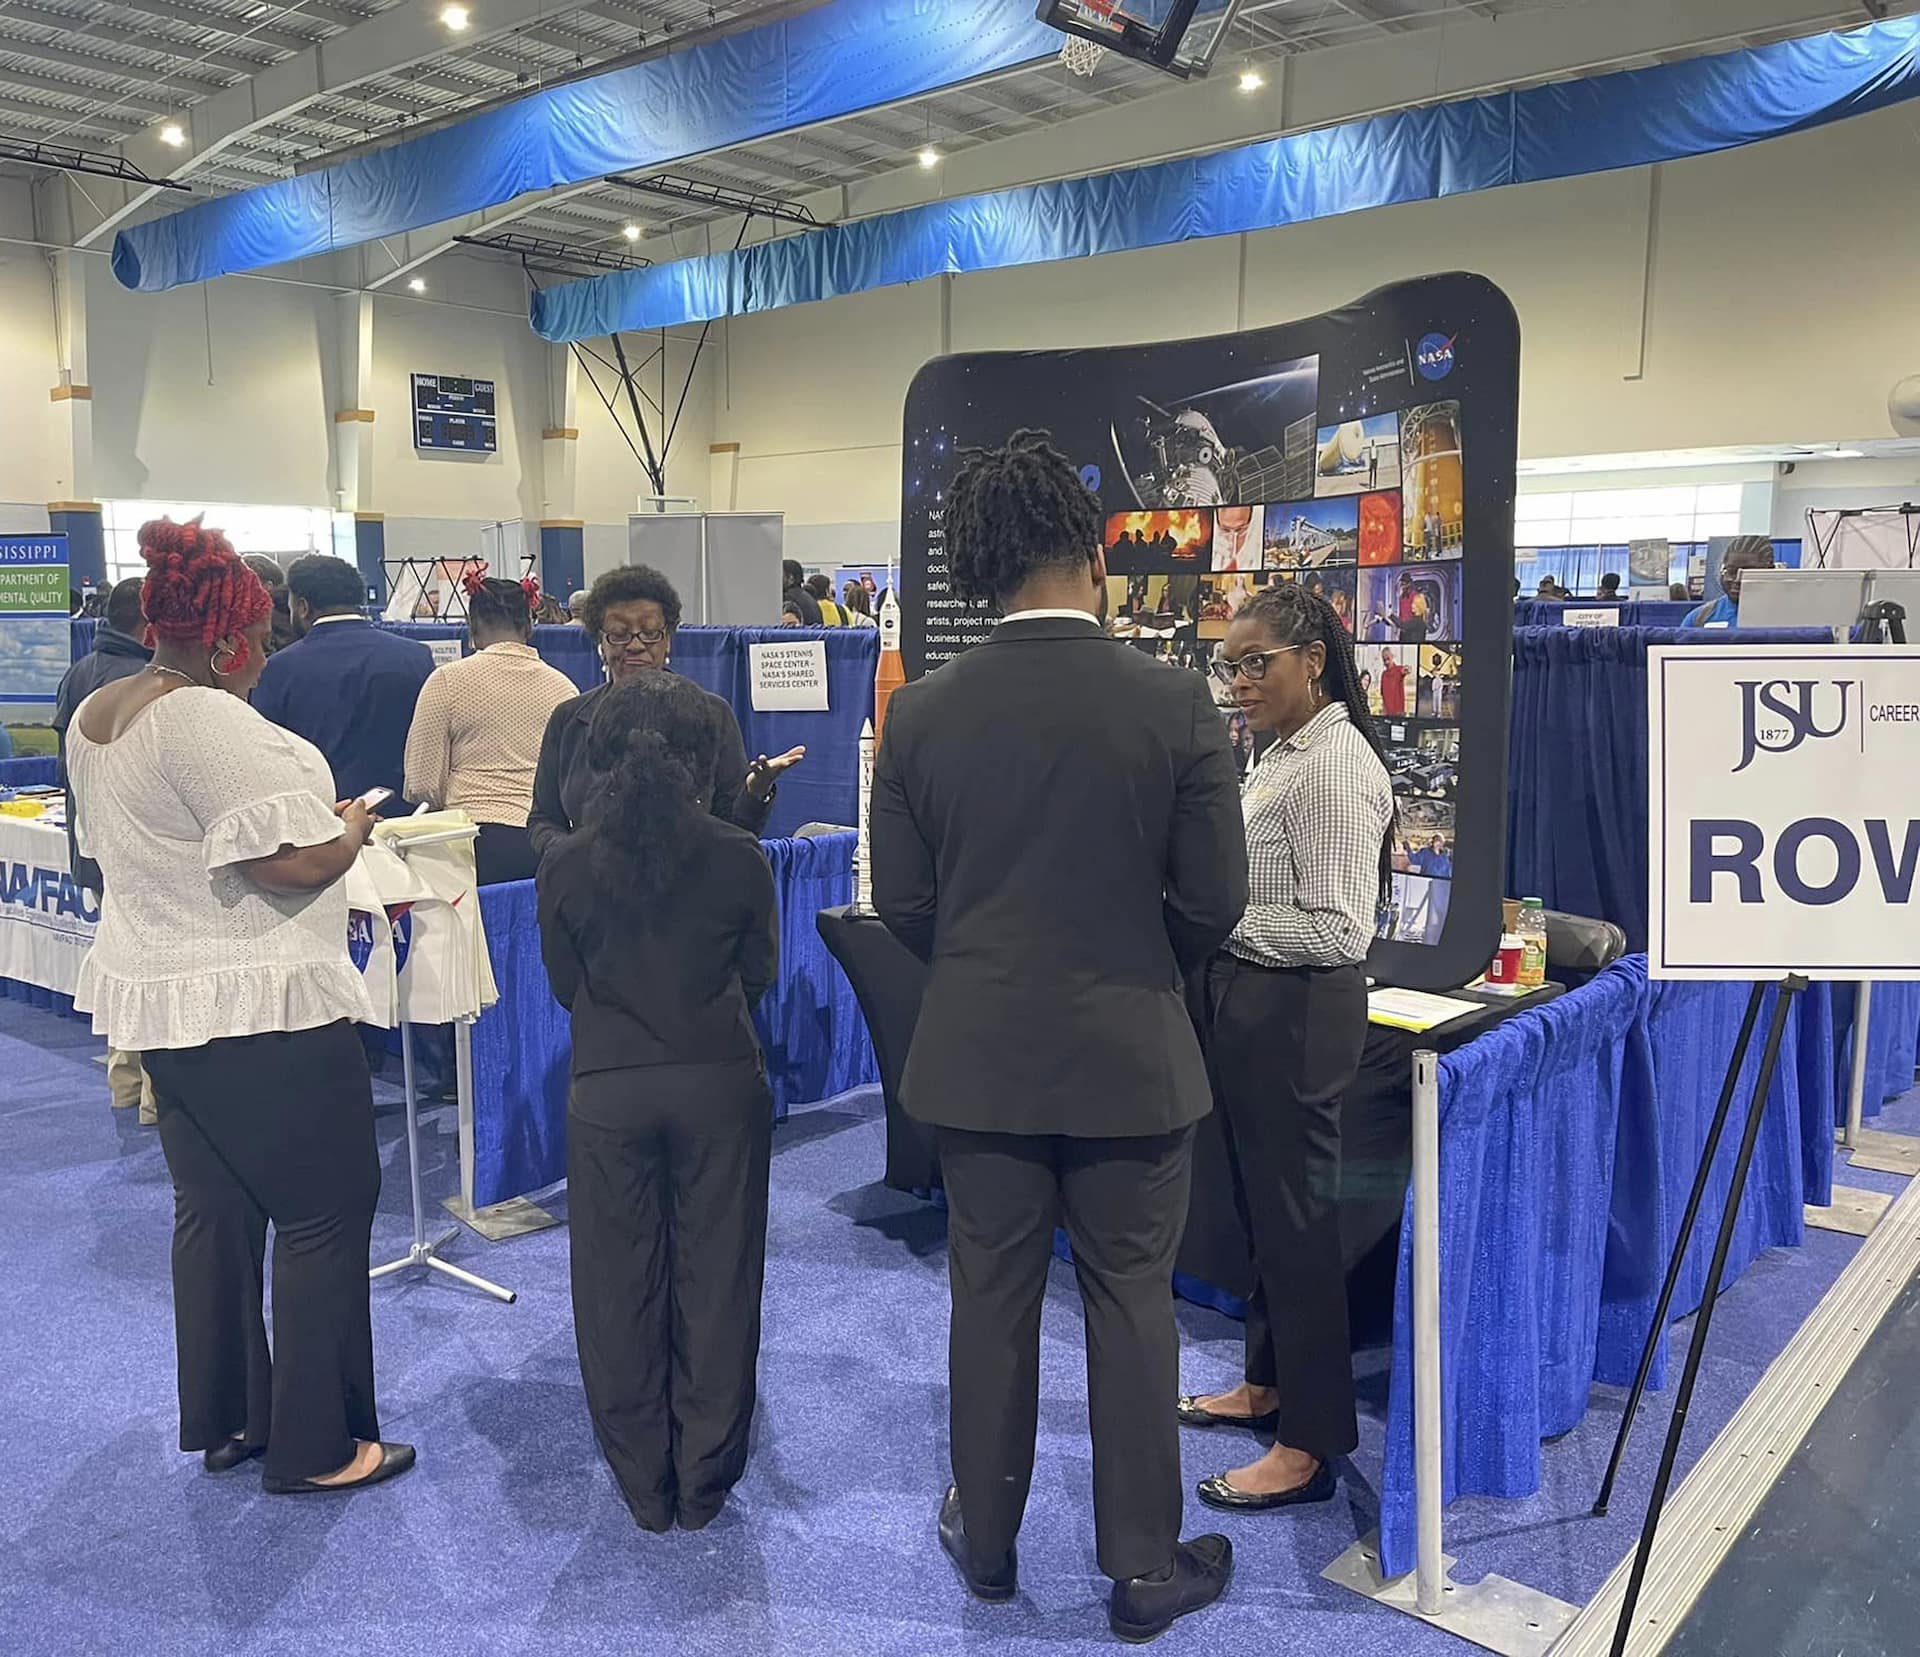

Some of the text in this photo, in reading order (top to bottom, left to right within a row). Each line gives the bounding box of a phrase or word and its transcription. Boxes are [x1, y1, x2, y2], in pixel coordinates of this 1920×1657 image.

[1418, 348, 1453, 366] NASA
[928, 546, 943, 555] and
[47, 573, 60, 585] OF
[30, 590, 63, 606] QUALITY
[954, 617, 982, 628] project
[926, 634, 960, 643] business
[786, 649, 813, 659] STENNIS
[761, 661, 782, 669] SPACE
[783, 660, 810, 669] CENTER
[762, 669, 815, 679] NASA'S SHARED
[760, 680, 819, 689] SERVICES CENTER
[1869, 704, 1920, 722] CAREER
[1731, 680, 1854, 772] JSU
[1760, 729, 1790, 741] 1877
